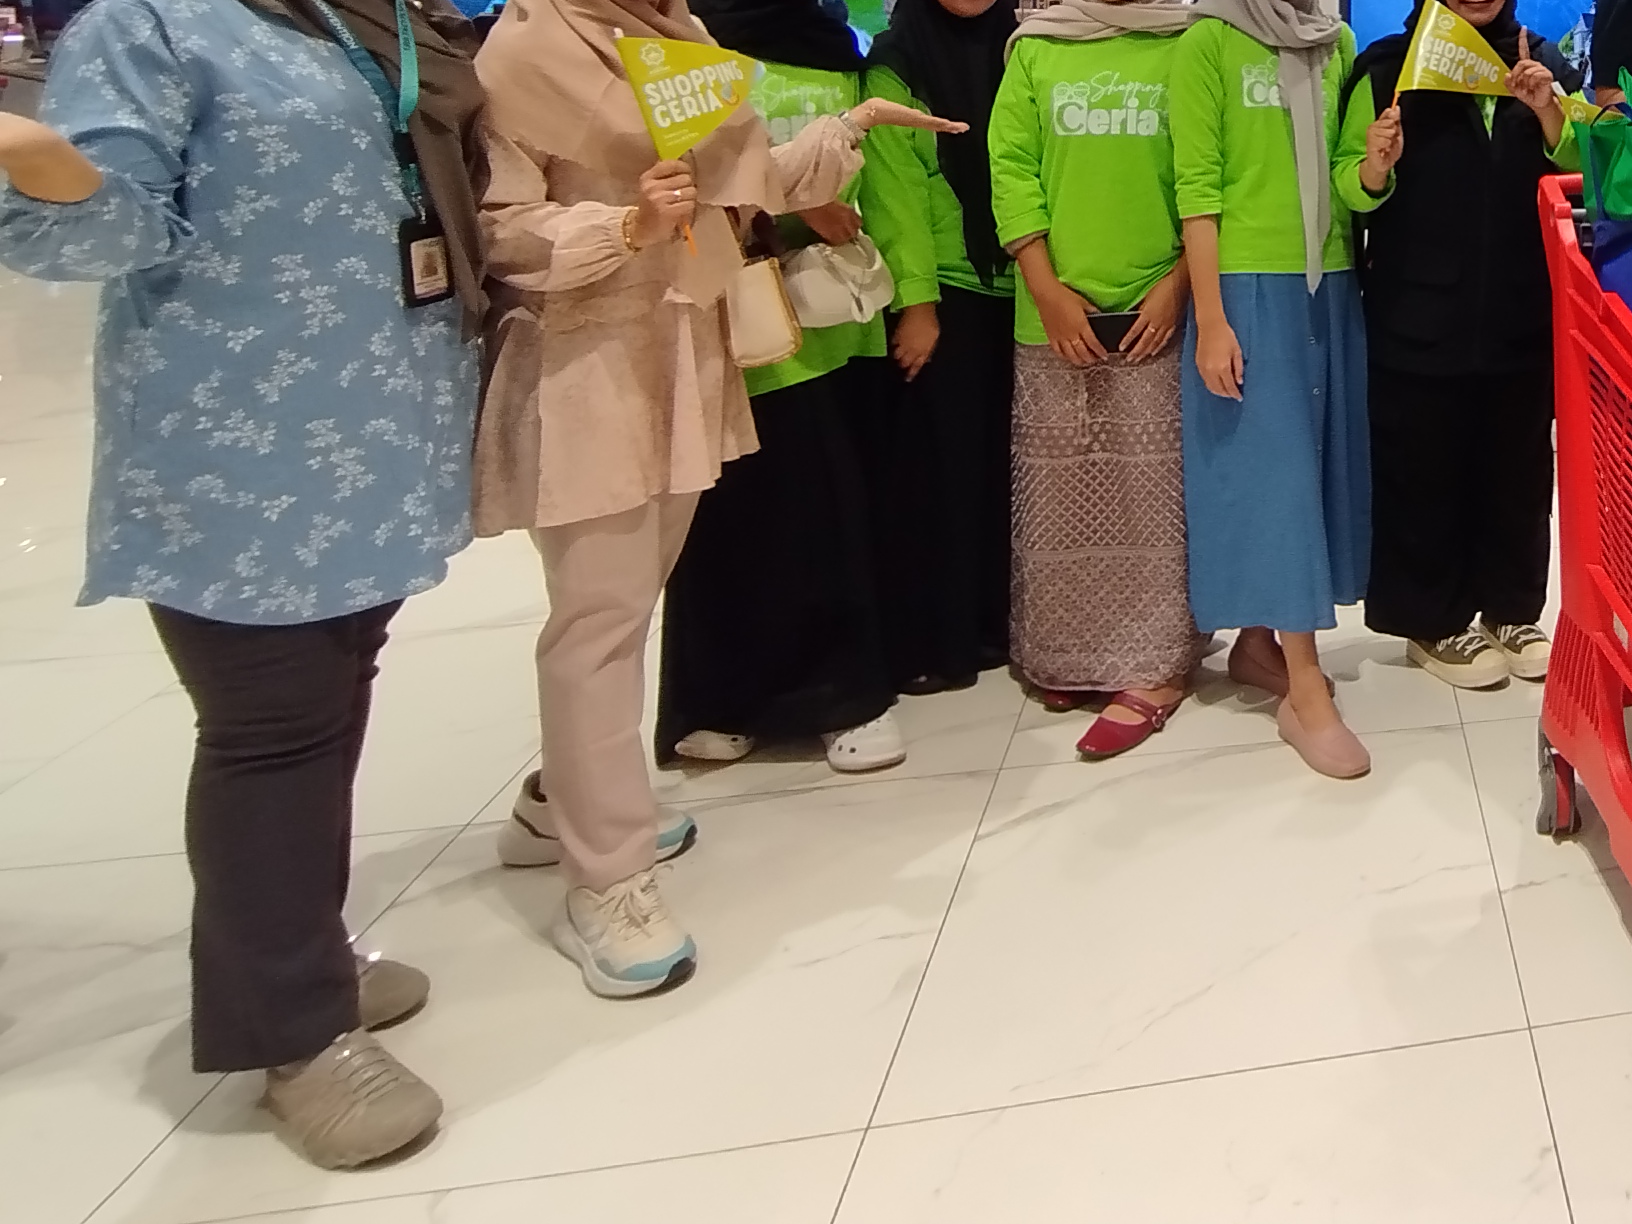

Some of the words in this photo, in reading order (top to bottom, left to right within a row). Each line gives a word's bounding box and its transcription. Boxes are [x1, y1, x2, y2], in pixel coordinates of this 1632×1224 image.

[1418, 53, 1464, 83] CERIA
[1421, 35, 1500, 83] SHOPPING
[643, 59, 744, 106] SHOPPING
[1090, 70, 1167, 107] Shopping
[653, 88, 723, 128] CERIA
[1054, 97, 1158, 136] Ceria
